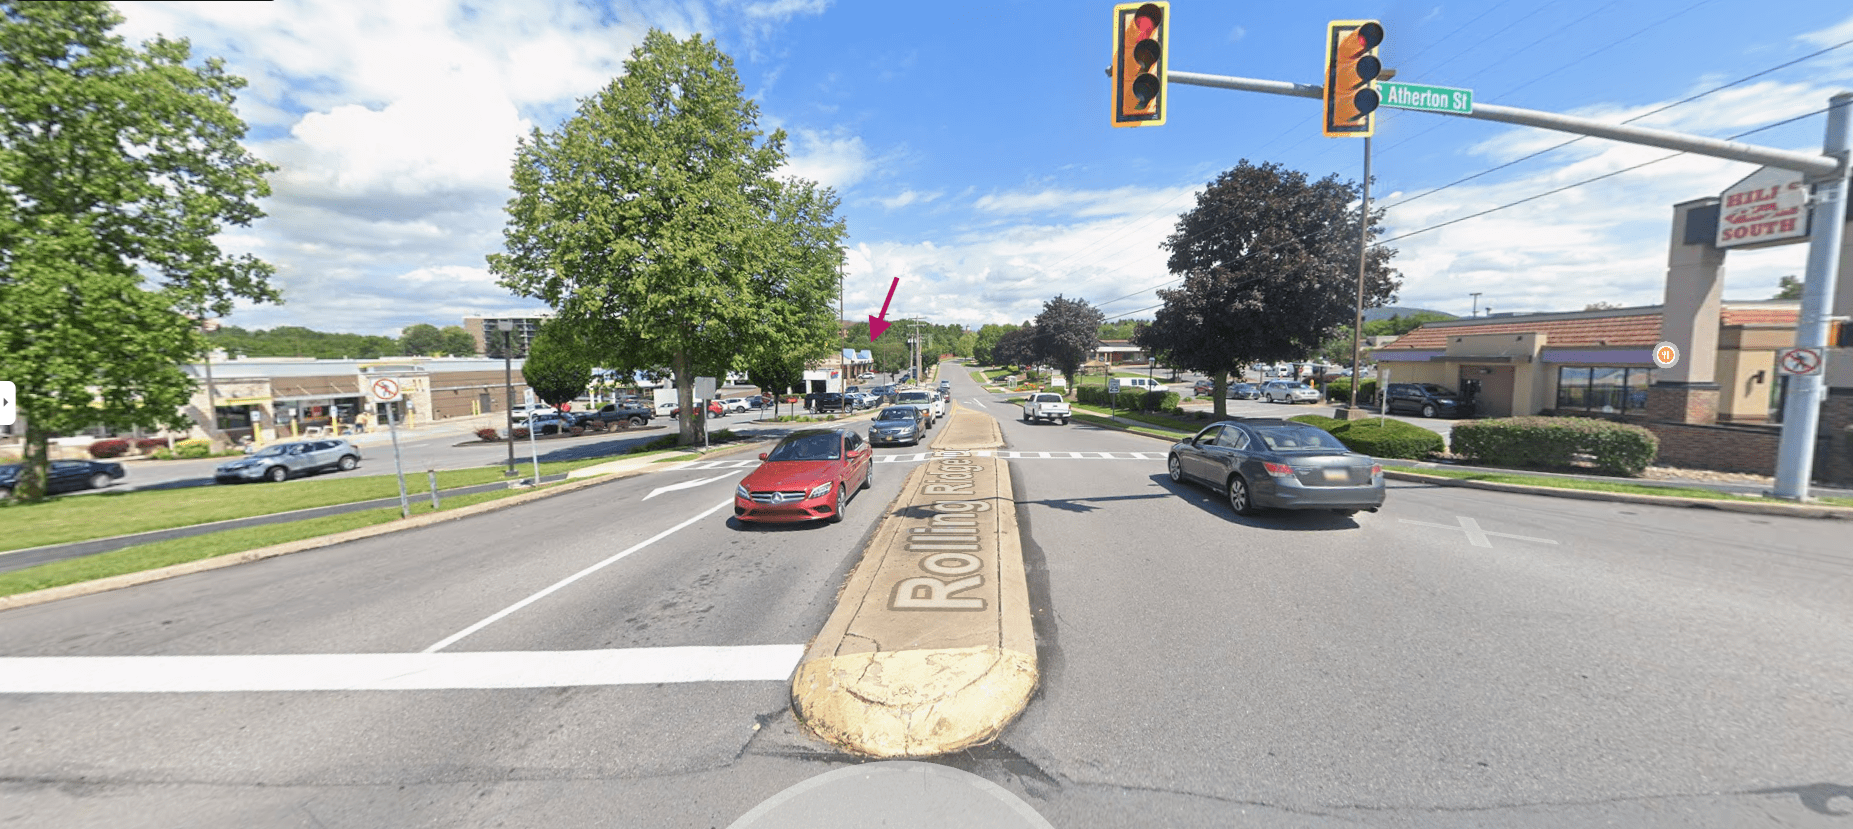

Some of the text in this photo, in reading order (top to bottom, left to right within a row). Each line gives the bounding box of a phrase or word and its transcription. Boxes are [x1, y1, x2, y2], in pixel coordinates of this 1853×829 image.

[1374, 84, 1468, 110] S Atherton St
[1726, 181, 1802, 208] HIL
[1721, 218, 1797, 241] SOUTH
